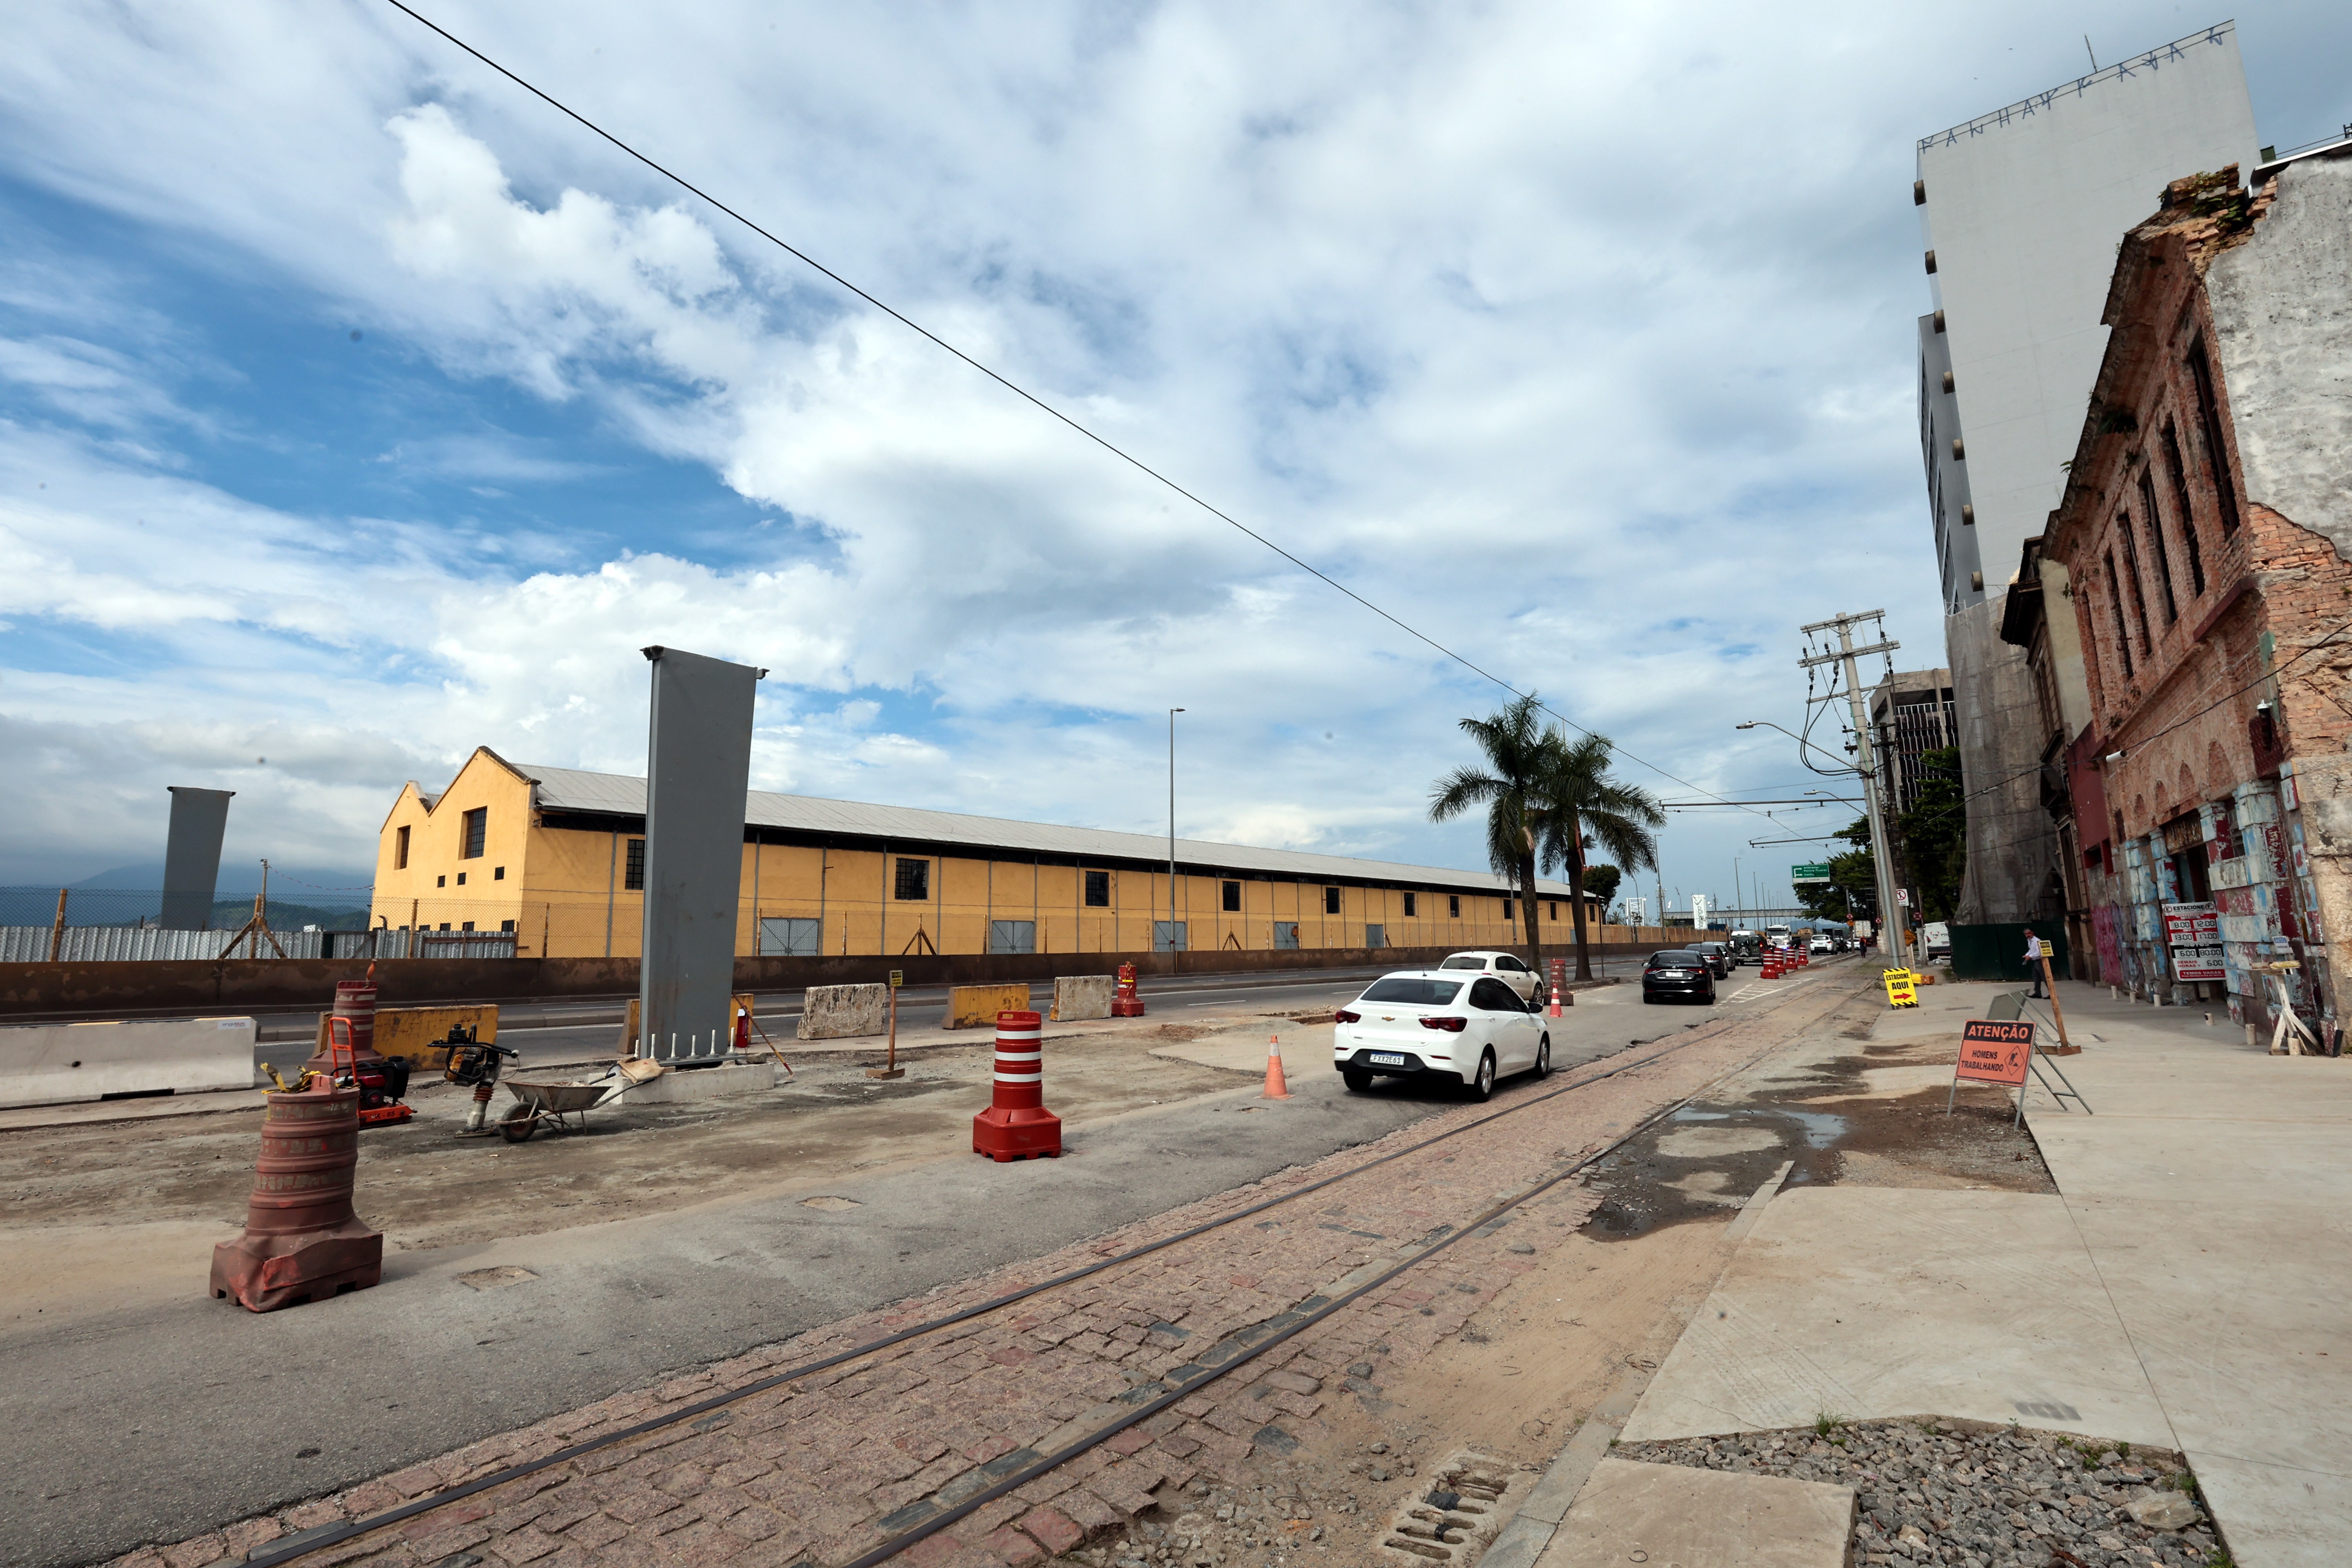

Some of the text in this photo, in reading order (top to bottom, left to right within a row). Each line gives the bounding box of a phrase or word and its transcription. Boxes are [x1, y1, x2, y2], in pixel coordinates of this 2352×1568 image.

[1892, 981, 1909, 990] AQUI
[1968, 1024, 2028, 1041] ATENÇÃO
[1374, 1055, 1400, 1063] FXX2E61
[1972, 1050, 1998, 1059] HOMENS
[1962, 1061, 2004, 1072] TRABALHANDO
